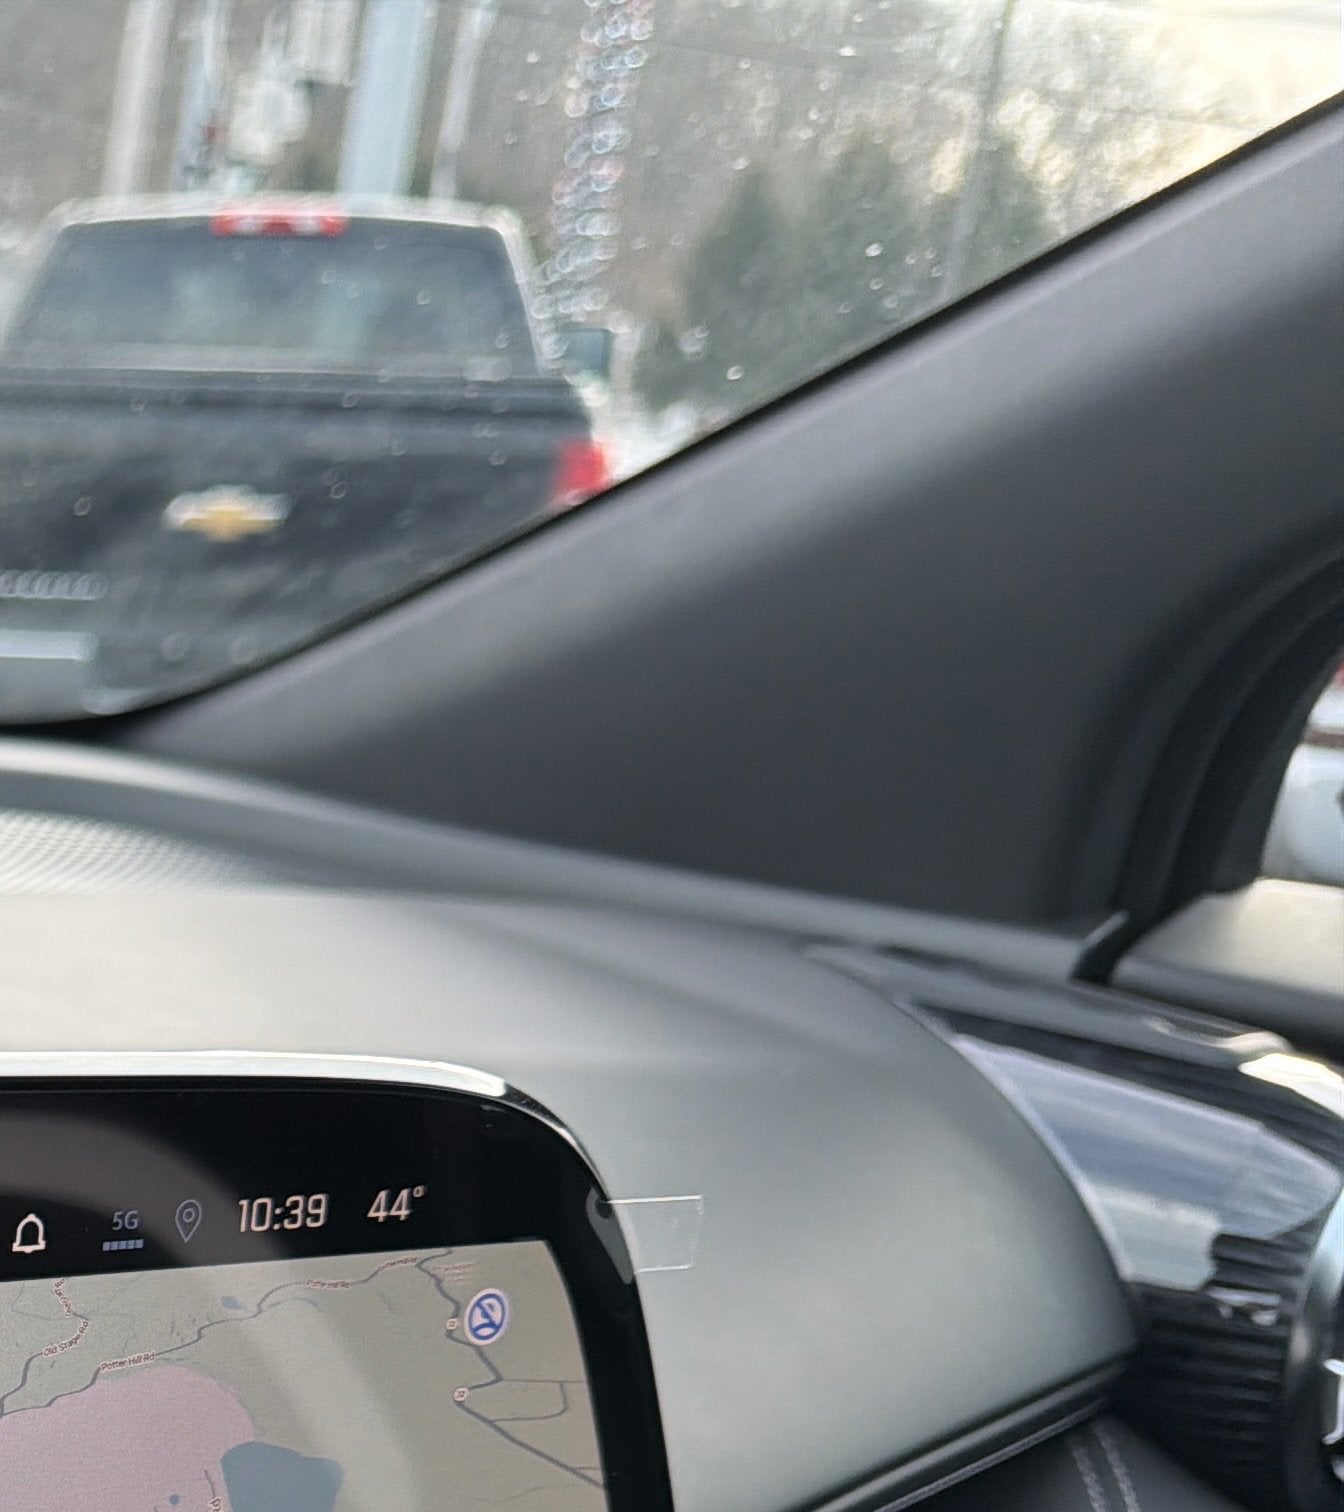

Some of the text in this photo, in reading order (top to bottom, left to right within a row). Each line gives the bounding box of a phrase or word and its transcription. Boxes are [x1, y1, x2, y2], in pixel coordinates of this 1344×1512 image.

[112, 1211, 139, 1230] 5G
[238, 1193, 328, 1232] 10:39
[367, 1185, 428, 1222] 44°
